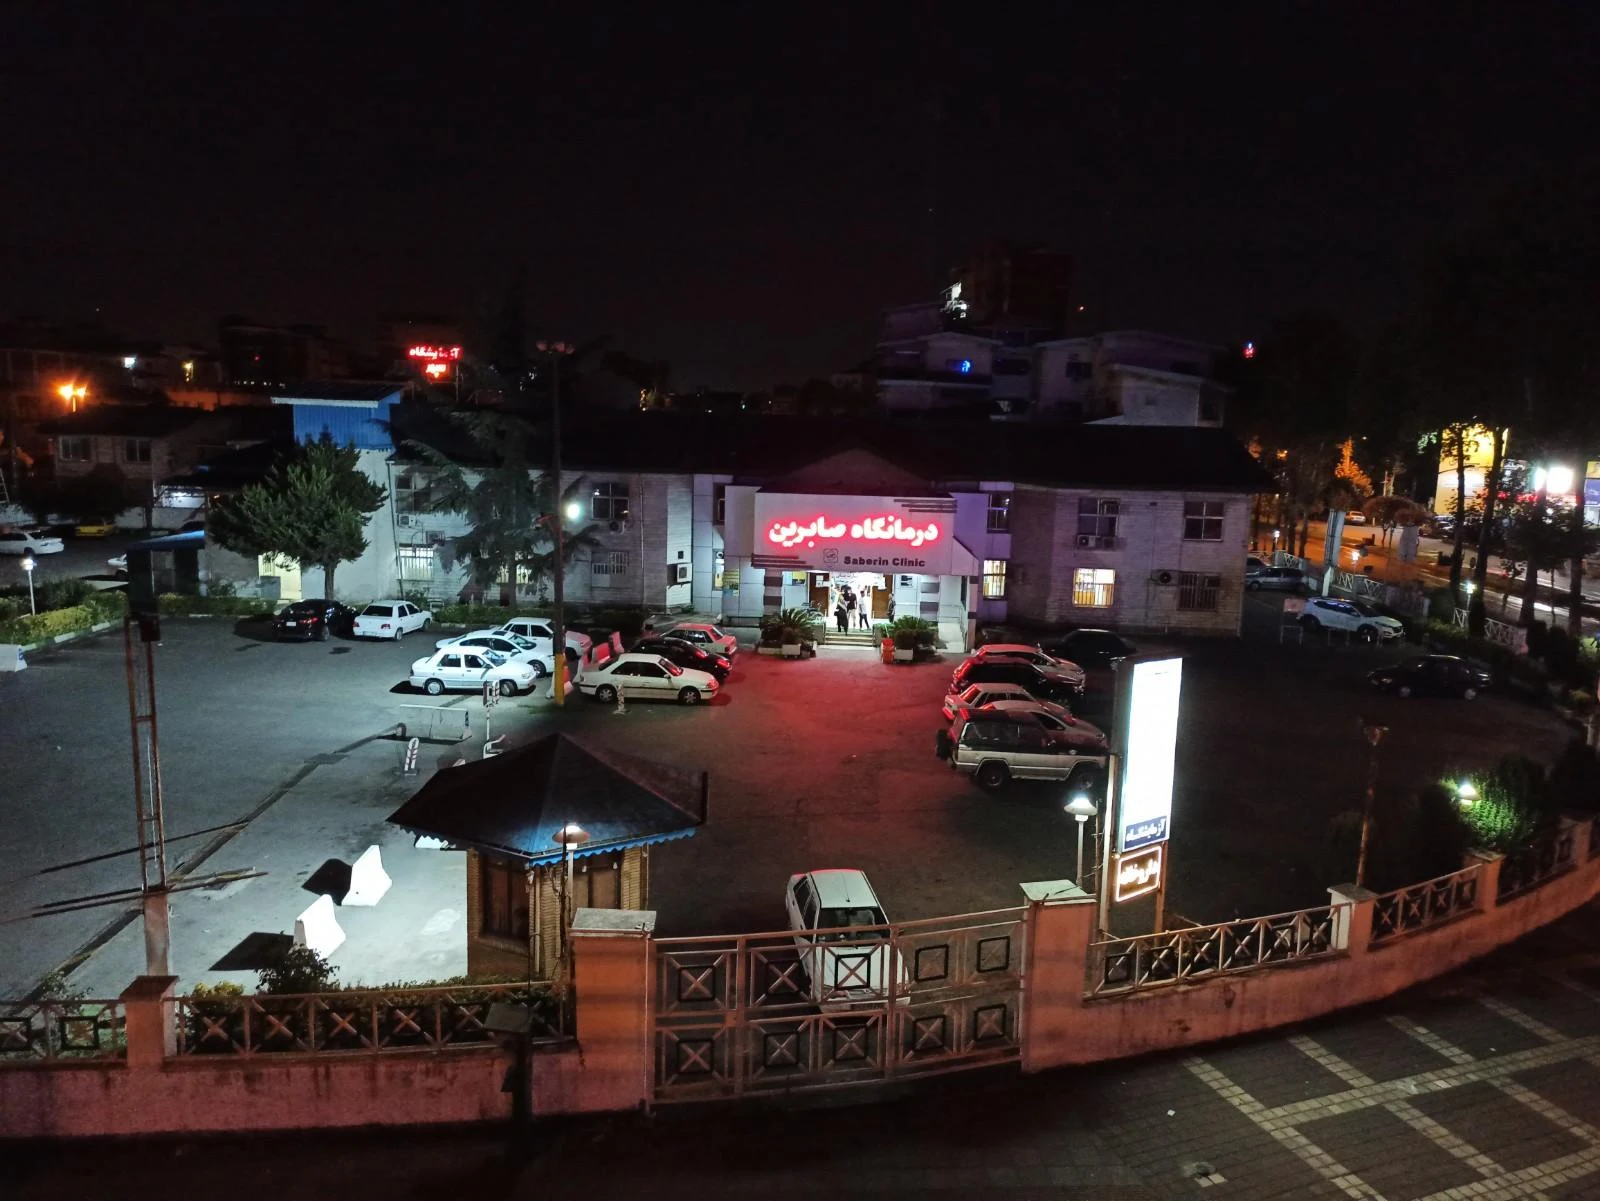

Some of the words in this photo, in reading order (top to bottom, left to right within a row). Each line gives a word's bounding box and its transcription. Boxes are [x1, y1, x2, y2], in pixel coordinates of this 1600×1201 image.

[768, 515, 847, 548] صابرین
[850, 515, 938, 547] درمانگاه
[843, 555, 889, 566] Saberin
[892, 556, 926, 567] Clinic
